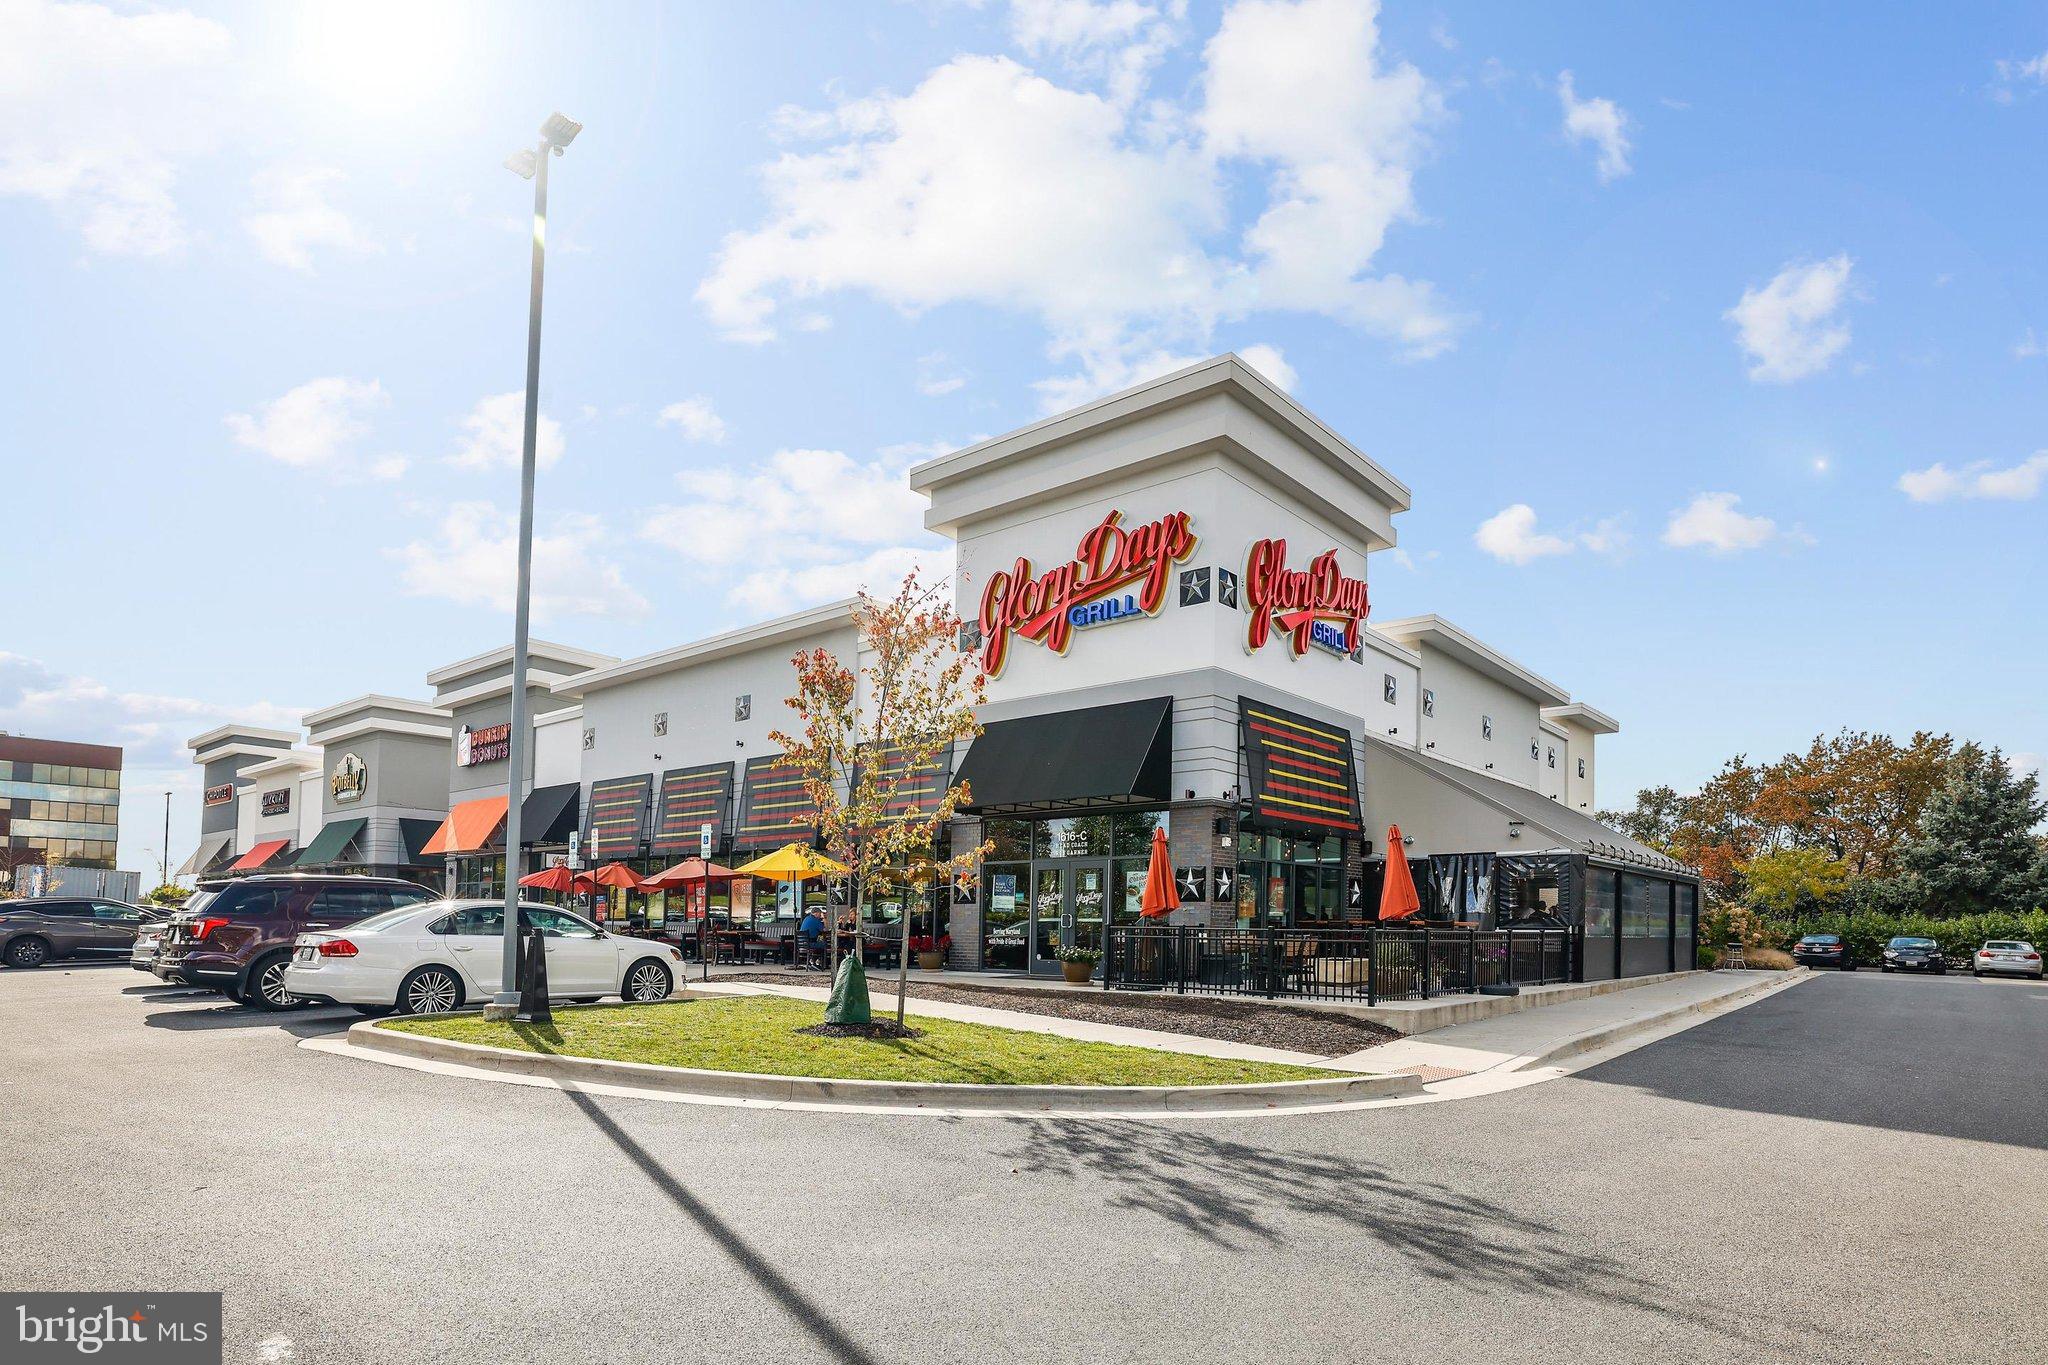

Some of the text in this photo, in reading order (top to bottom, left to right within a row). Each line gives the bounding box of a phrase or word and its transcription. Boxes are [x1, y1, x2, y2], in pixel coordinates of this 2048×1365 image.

[979, 509, 1199, 676] Glory Days
[1246, 538, 1371, 655] Glory Days
[1068, 594, 1141, 627] GRILL
[1312, 620, 1350, 653] GRILL
[470, 742, 509, 764] DONUTS
[1058, 831, 1087, 842] 1616-C
